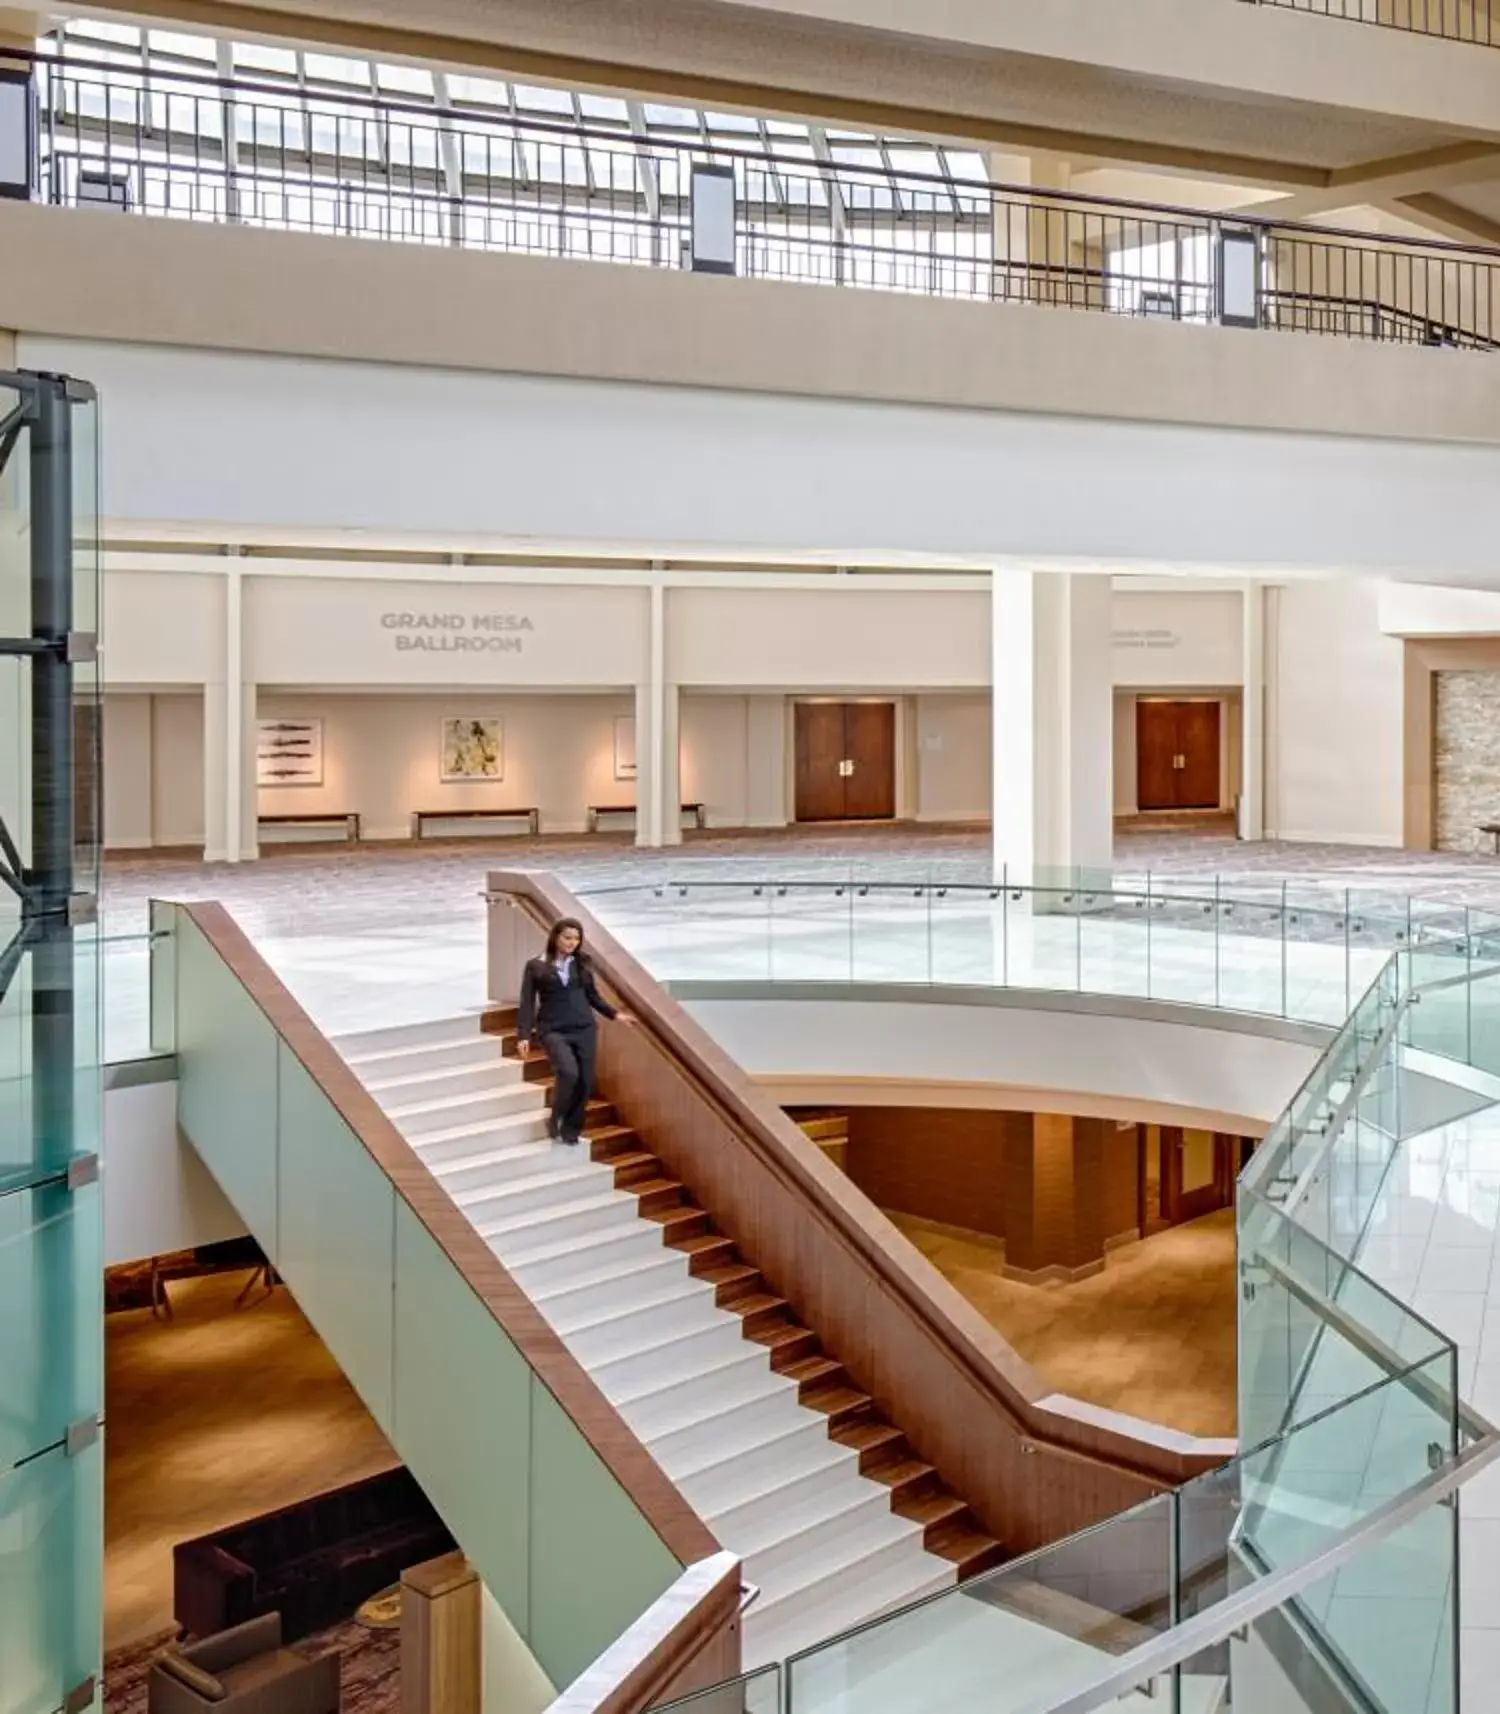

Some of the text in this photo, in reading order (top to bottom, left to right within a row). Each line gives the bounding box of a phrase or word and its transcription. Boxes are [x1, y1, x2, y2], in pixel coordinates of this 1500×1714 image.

[381, 613, 534, 631] GRAND MESA
[396, 635, 521, 652] BALLROOM
